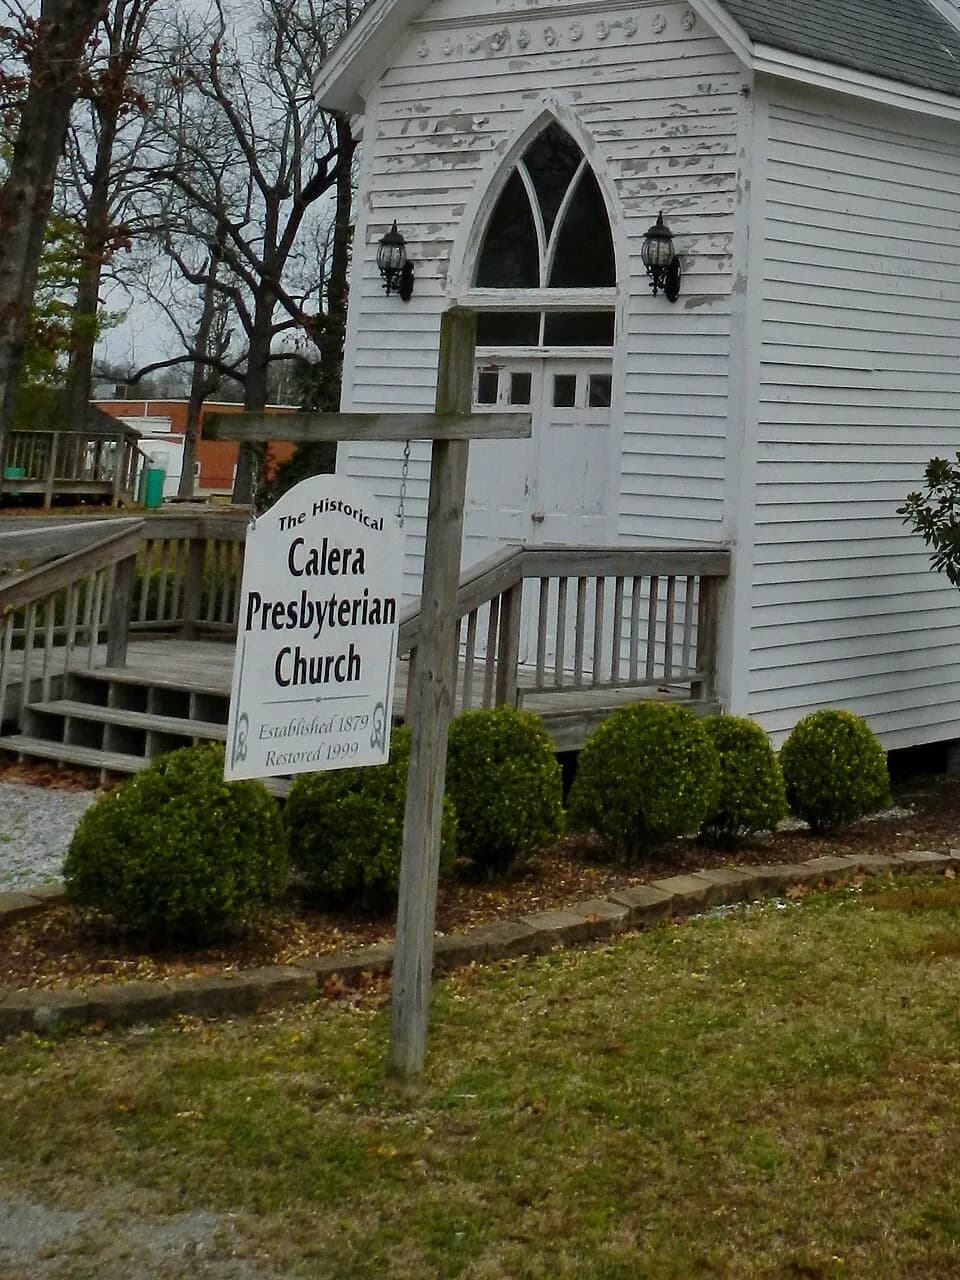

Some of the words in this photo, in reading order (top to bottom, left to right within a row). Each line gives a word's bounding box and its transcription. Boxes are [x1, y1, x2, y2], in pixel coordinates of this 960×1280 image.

[279, 512, 306, 531] The
[312, 497, 384, 531] Historical
[288, 537, 365, 577] Calera
[245, 587, 396, 640] Presbyterian
[274, 643, 361, 688] Church
[258, 714, 337, 740] Established
[338, 714, 369, 733] 1879
[265, 742, 325, 768] Restored
[326, 742, 359, 760] 1999
